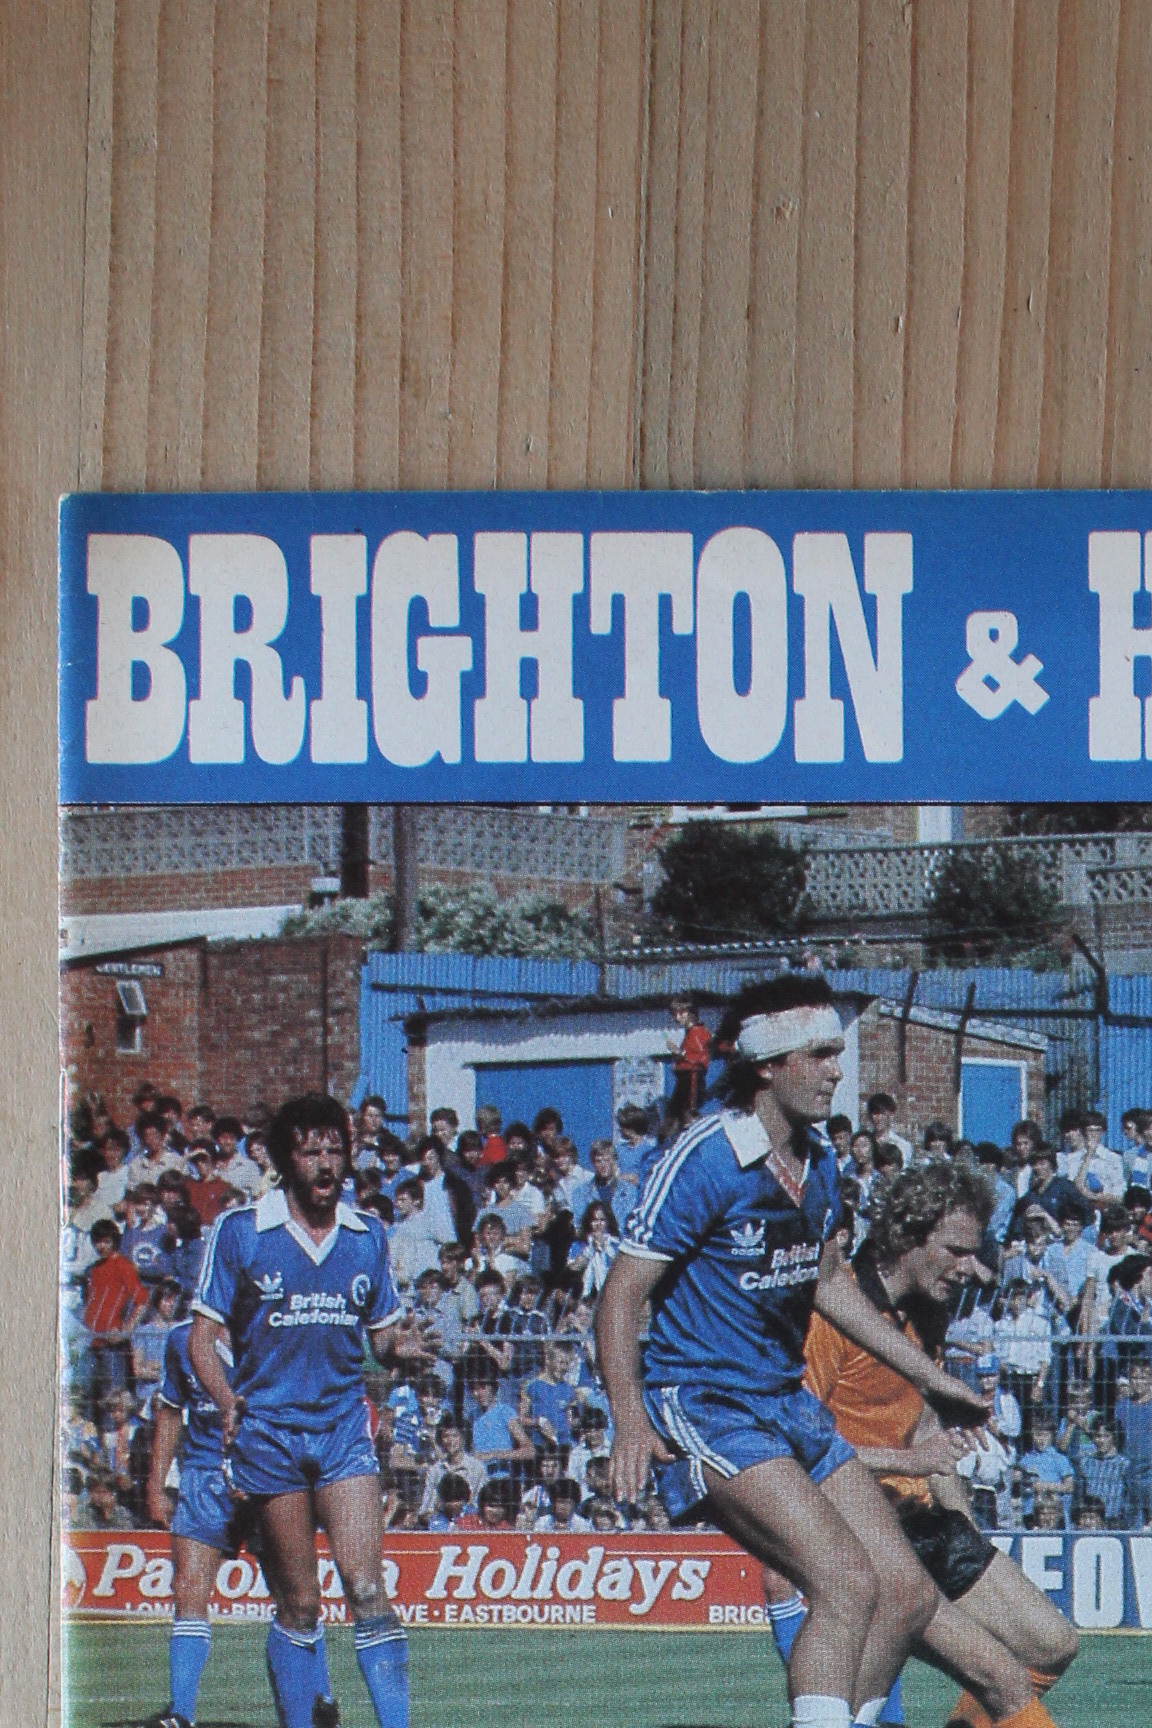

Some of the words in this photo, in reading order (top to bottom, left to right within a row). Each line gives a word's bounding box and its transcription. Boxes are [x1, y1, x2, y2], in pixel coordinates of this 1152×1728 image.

[85, 526, 913, 767] BRIGHTON
[955, 610, 1050, 719] &
[425, 1545, 712, 1615] Holidays
[448, 1605, 597, 1624] EASTBOURNE
